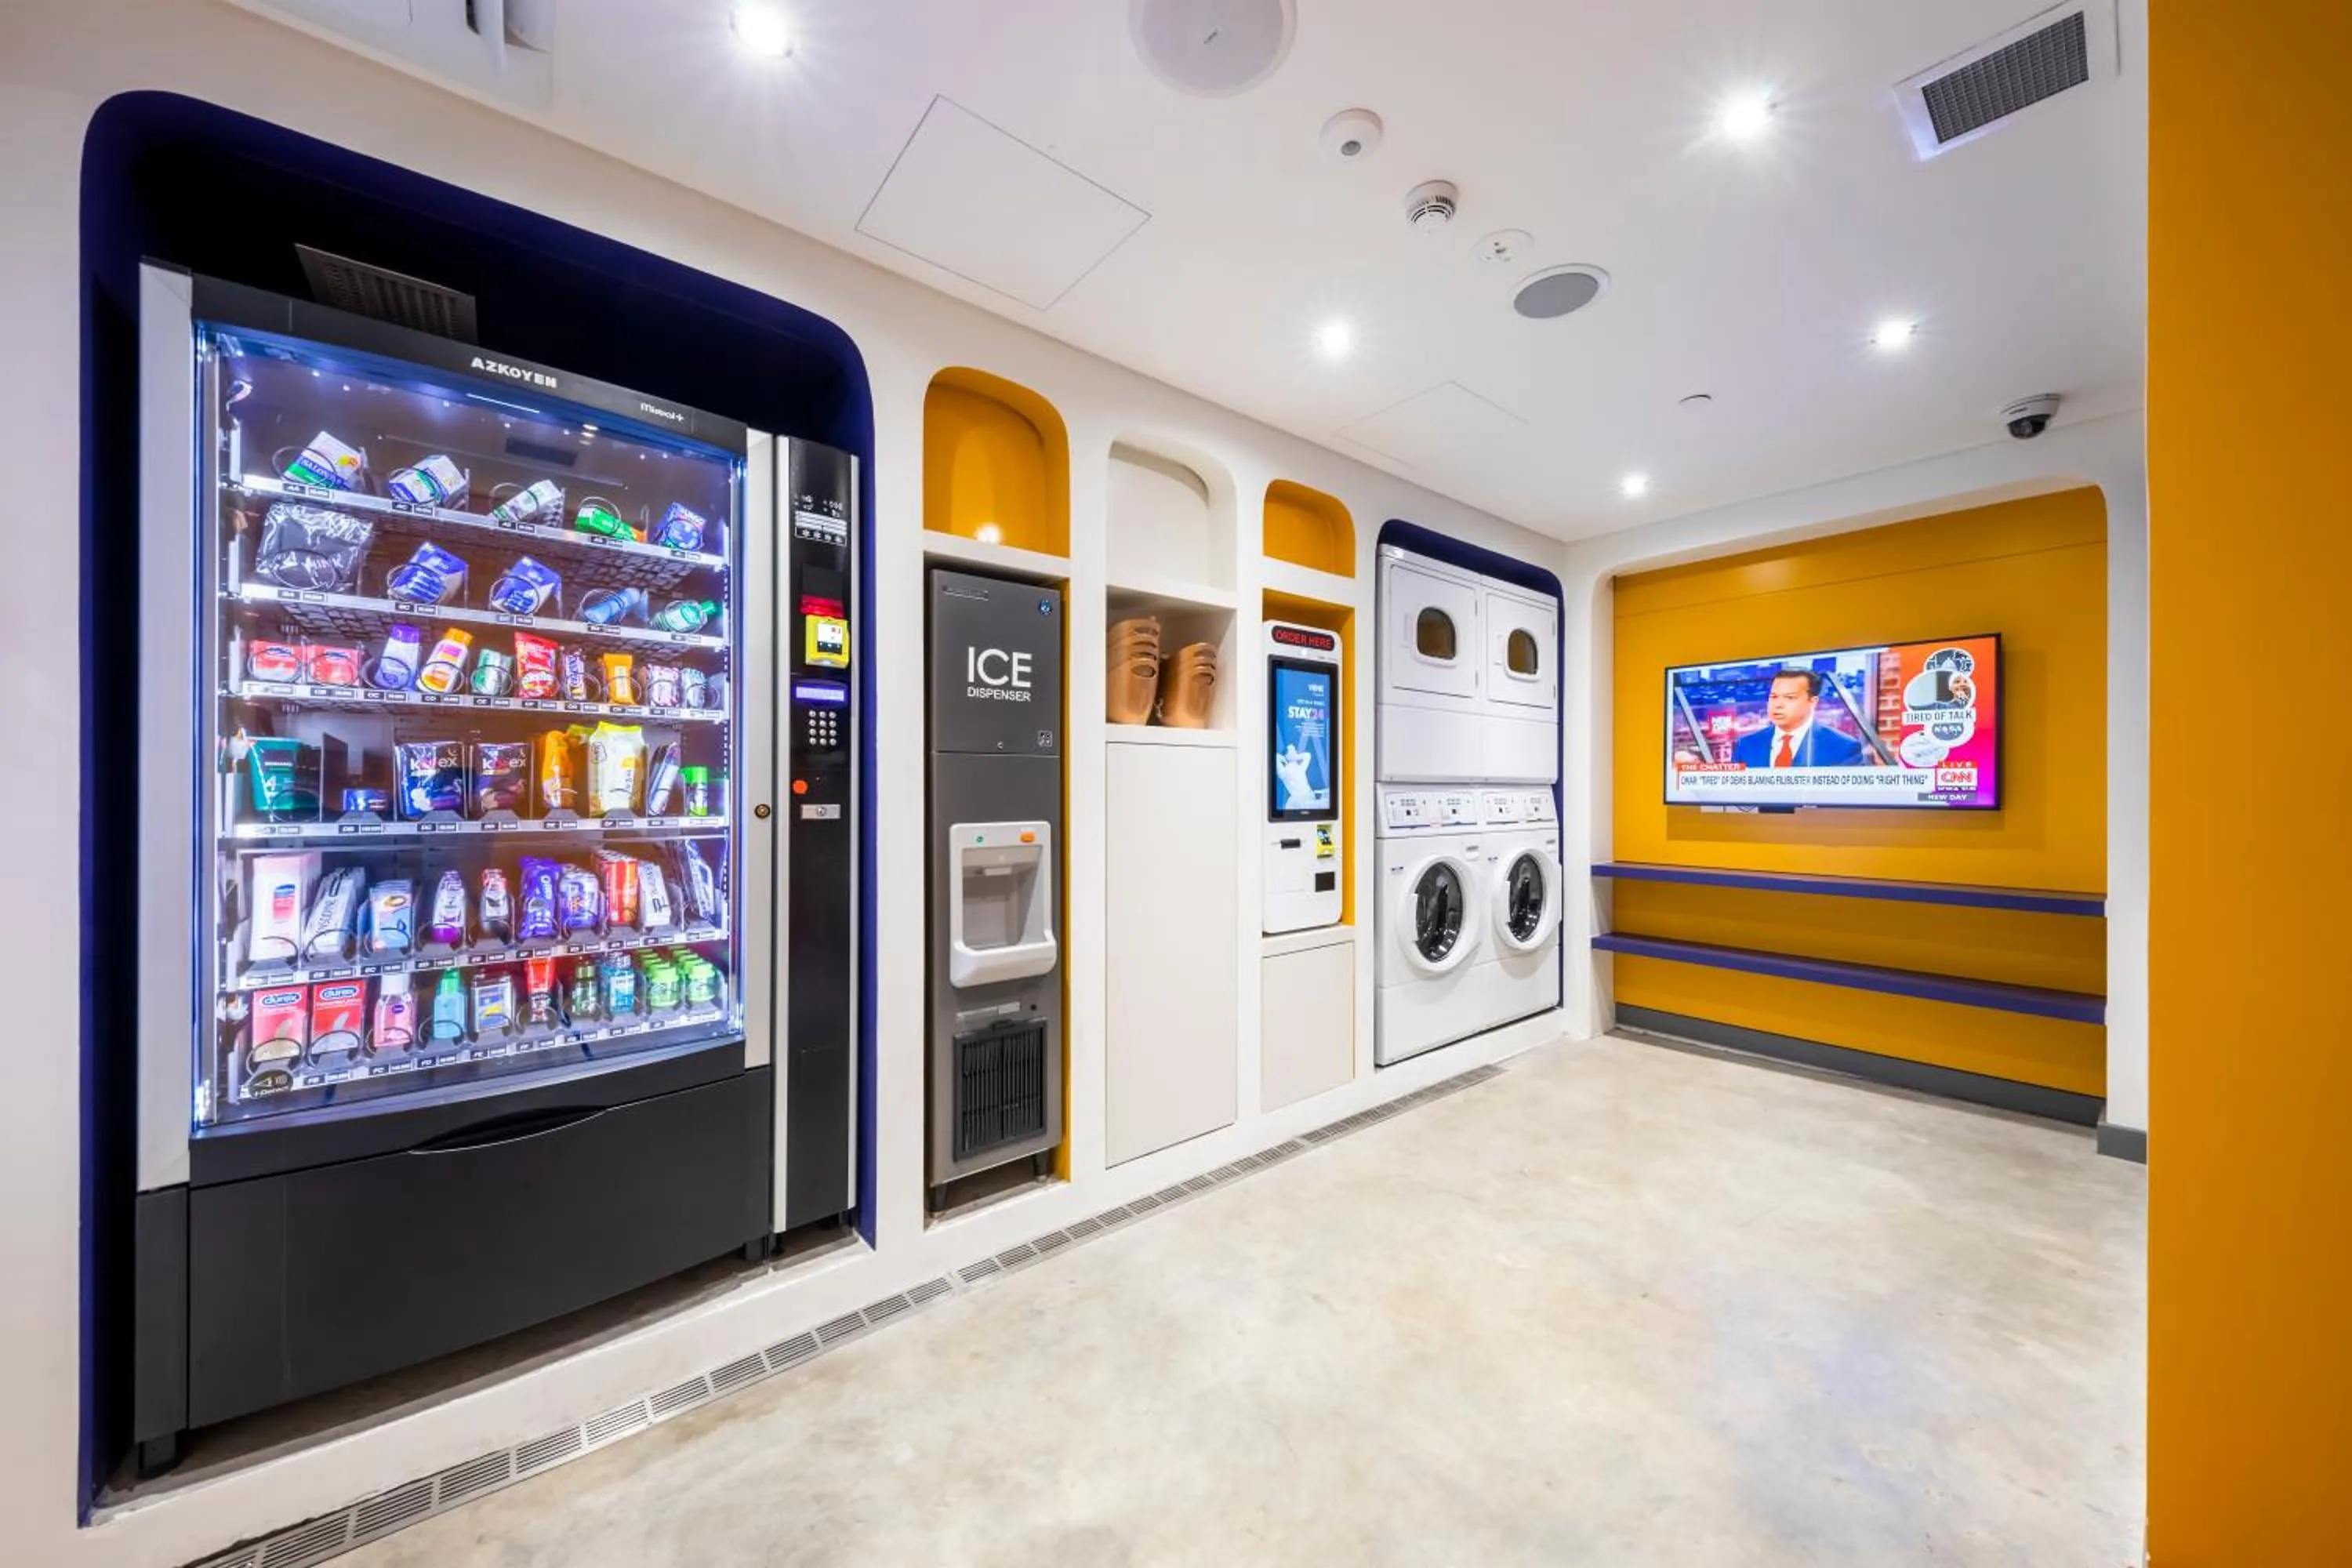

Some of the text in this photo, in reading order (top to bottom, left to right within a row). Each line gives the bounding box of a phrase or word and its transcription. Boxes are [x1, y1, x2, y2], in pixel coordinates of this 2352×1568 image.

[470, 357, 557, 389] AZKOYEN
[1276, 629, 1331, 649] ORDER HERE
[967, 646, 1033, 688] ICE
[967, 686, 1032, 702] DISPENSER
[1934, 711, 1947, 720] OF
[1949, 710, 1972, 720] TALK
[1700, 763, 1741, 771] CHATTER
[1748, 775, 1775, 785] BLAMING
[1776, 775, 1810, 785] FILIBUSTER
[1812, 774, 1840, 785] INSTEAD
[1841, 774, 1851, 785] OF
[1851, 774, 1875, 785] DOING
[1940, 771, 1973, 782] CNN
[323, 987, 355, 999] durex
[263, 993, 298, 1006] durex
